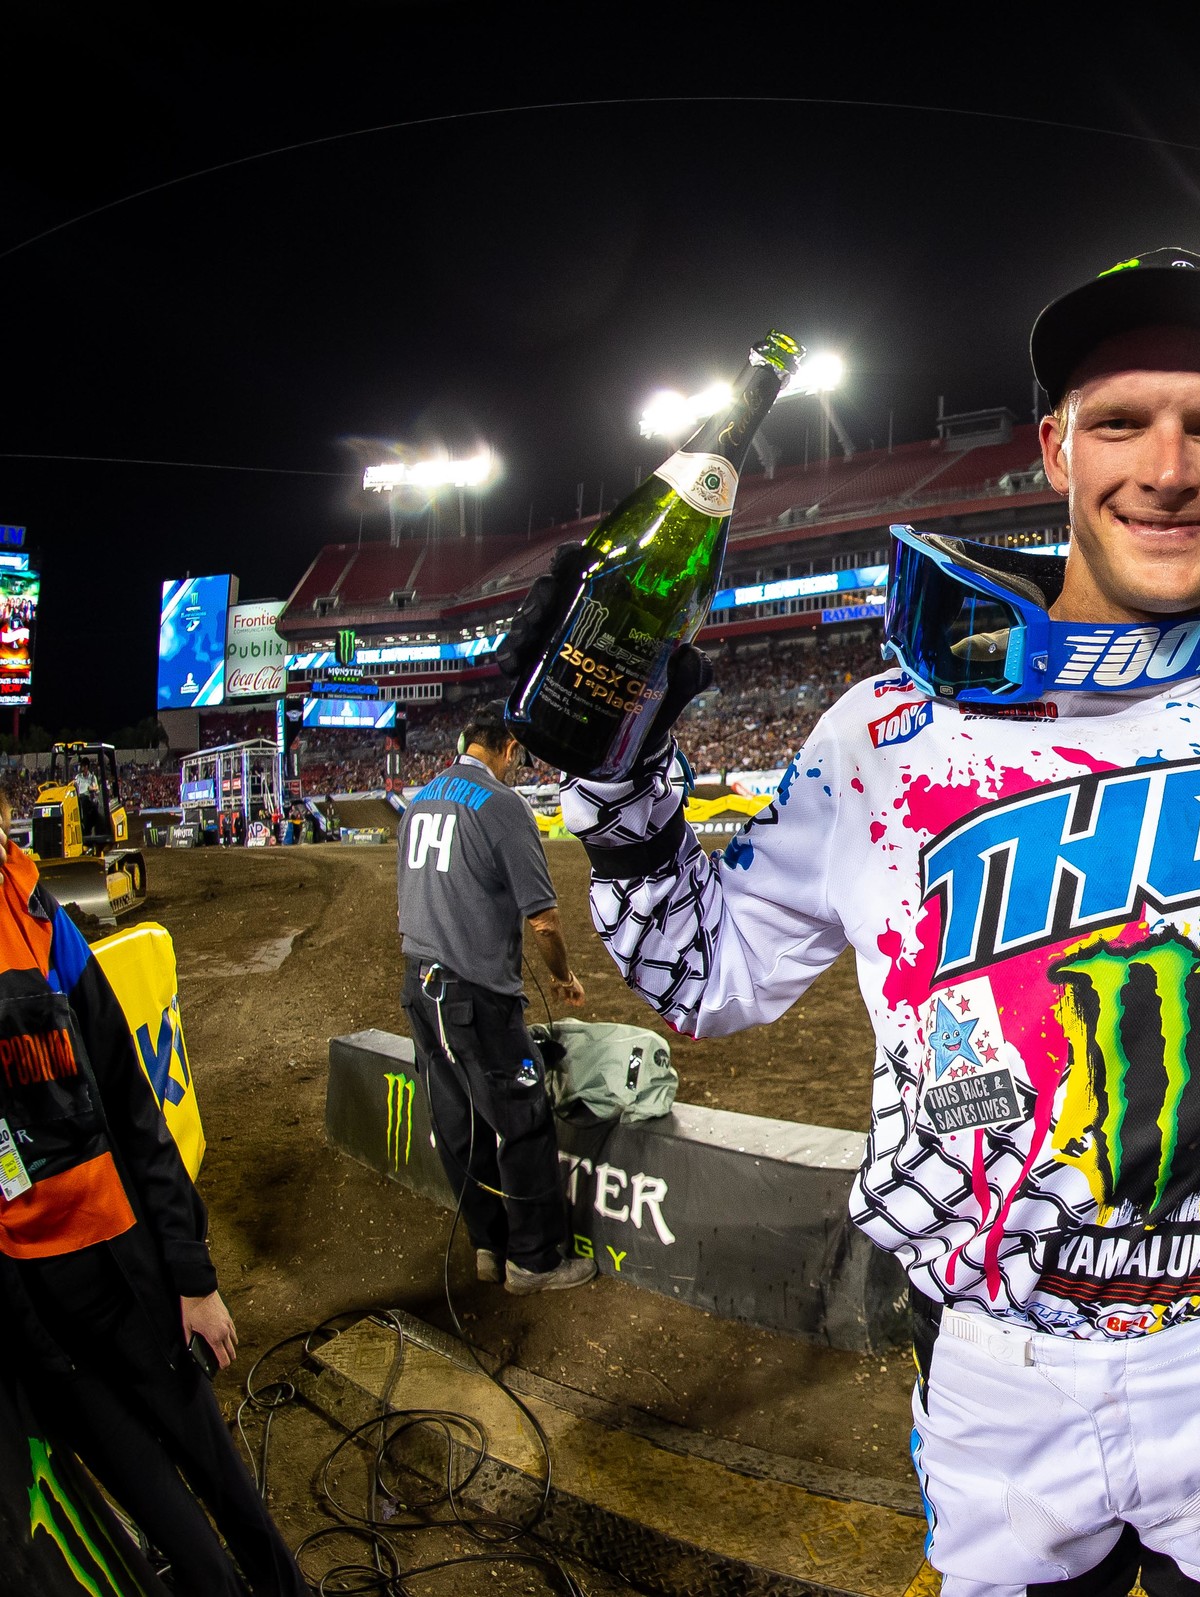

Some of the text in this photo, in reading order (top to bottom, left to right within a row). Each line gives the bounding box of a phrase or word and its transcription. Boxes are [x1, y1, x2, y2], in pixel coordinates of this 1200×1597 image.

[226, 639, 283, 660] Publix
[327, 667, 364, 677] MONSTER
[559, 642, 665, 701] 250SX Class
[591, 683, 644, 715] Place
[874, 701, 927, 746] 100%
[444, 777, 493, 812] CREW
[407, 812, 457, 873] 04
[0, 1028, 78, 1088] PODIUM
[927, 1076, 990, 1110] THIS RACE
[935, 1096, 1011, 1131] SAVES LIVES
